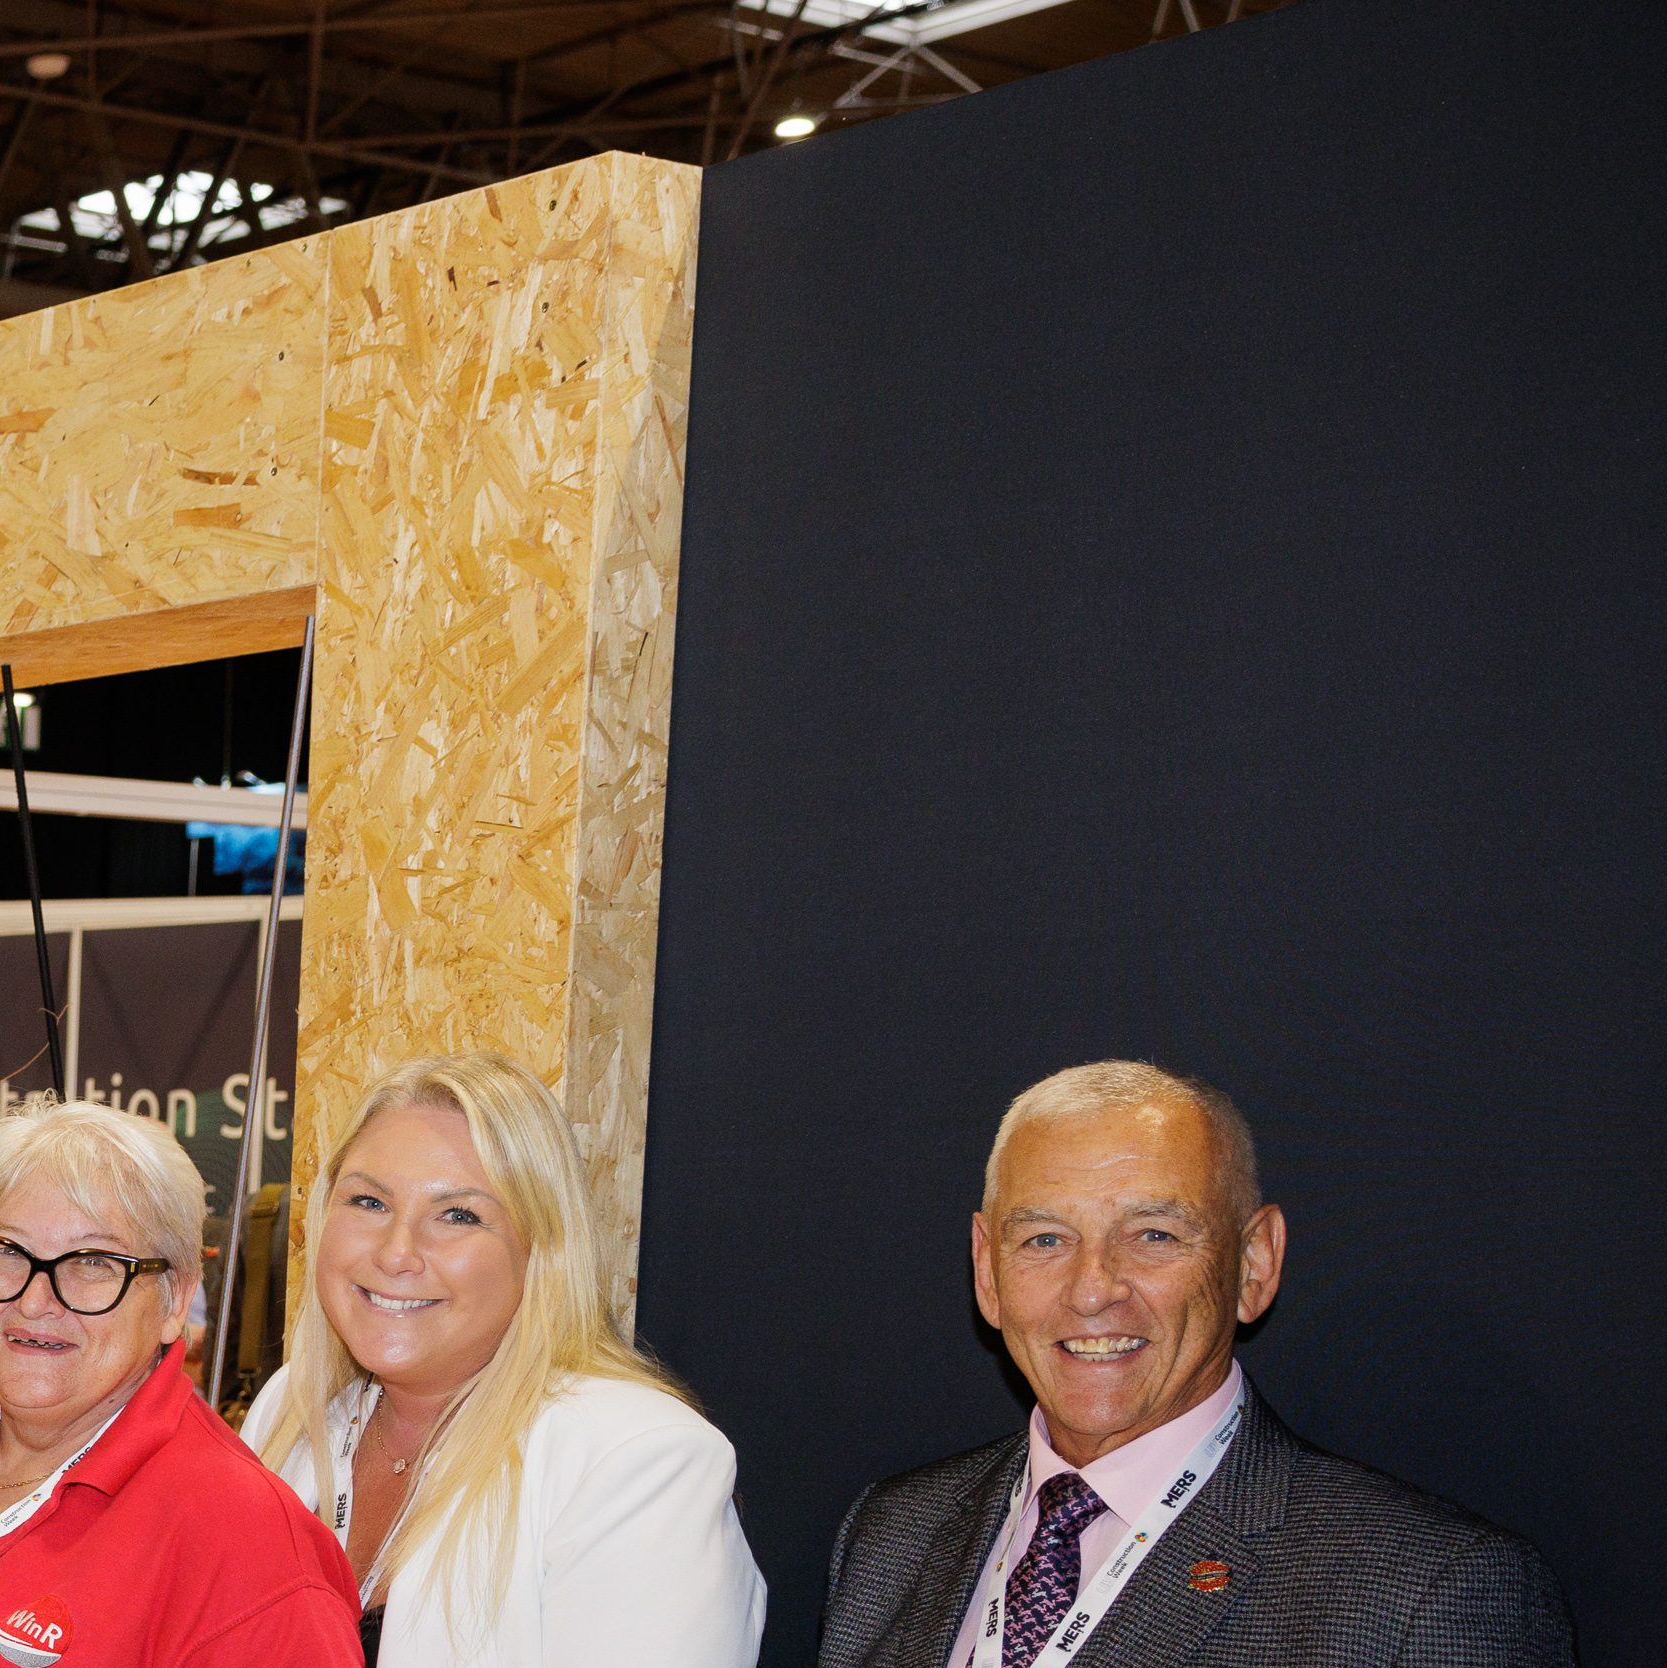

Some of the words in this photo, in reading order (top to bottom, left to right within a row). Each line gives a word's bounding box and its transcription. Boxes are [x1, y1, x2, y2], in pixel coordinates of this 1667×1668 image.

[1160, 1470, 1197, 1509] MERS
[334, 1493, 347, 1530] MERS
[1107, 1541, 1136, 1578] Construction
[1113, 1562, 1128, 1580] Week
[6, 1609, 63, 1650] WinR
[985, 1597, 999, 1638] MERS
[1056, 1611, 1090, 1653] MERS
